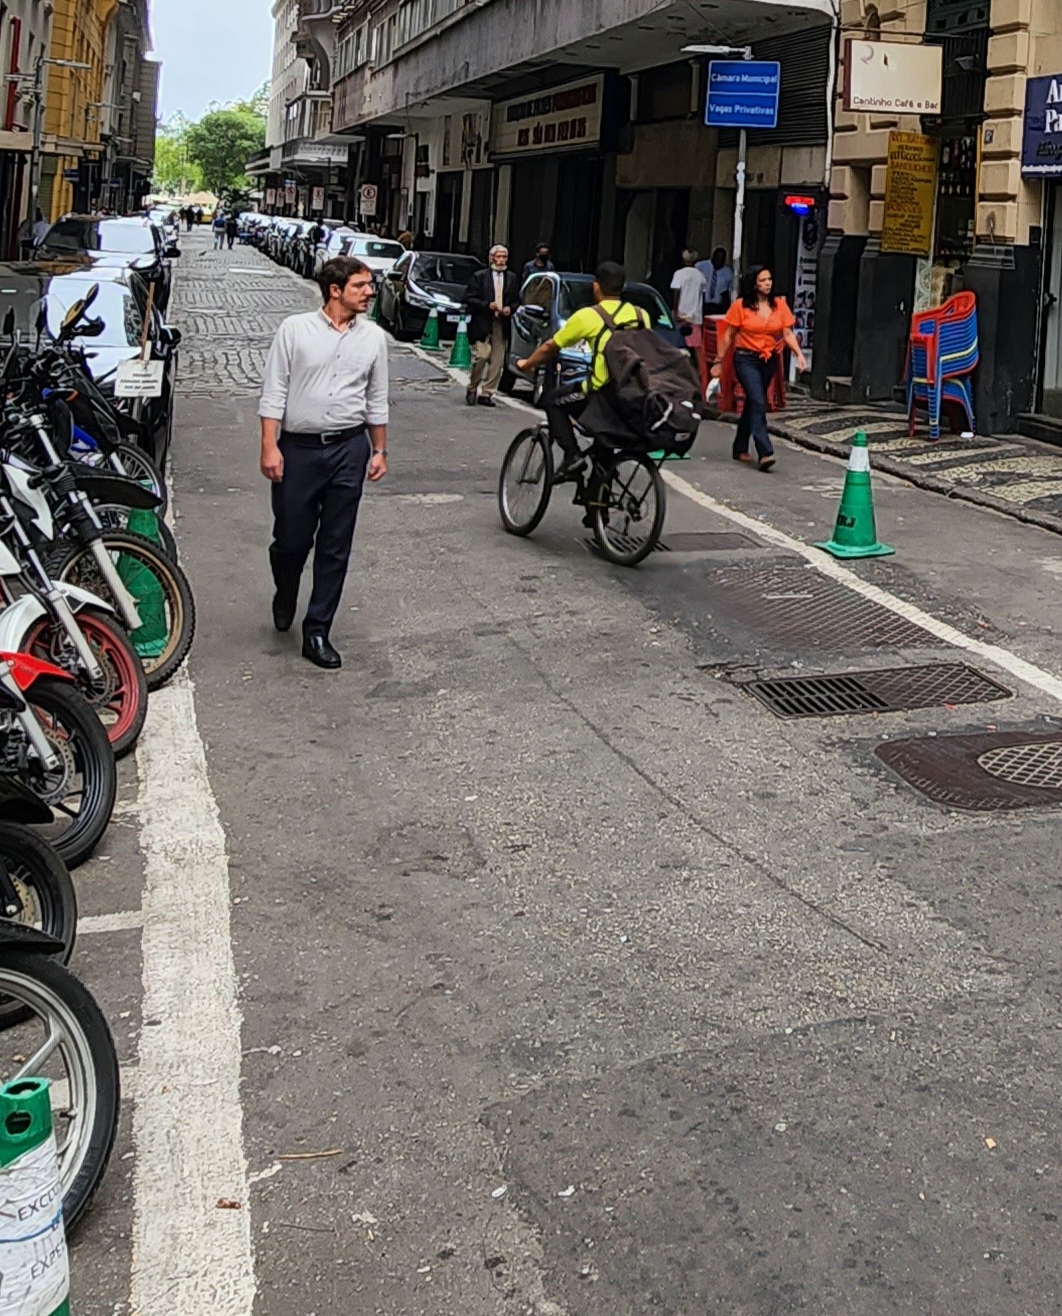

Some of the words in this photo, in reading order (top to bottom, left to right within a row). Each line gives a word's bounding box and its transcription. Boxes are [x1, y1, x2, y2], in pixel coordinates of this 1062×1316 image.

[711, 73, 740, 82] Câmara
[741, 74, 778, 84] Municipal
[853, 96, 892, 106] Cantinho
[925, 100, 938, 109] Bar
[709, 104, 732, 115] Vagas
[734, 104, 774, 115] Privativas
